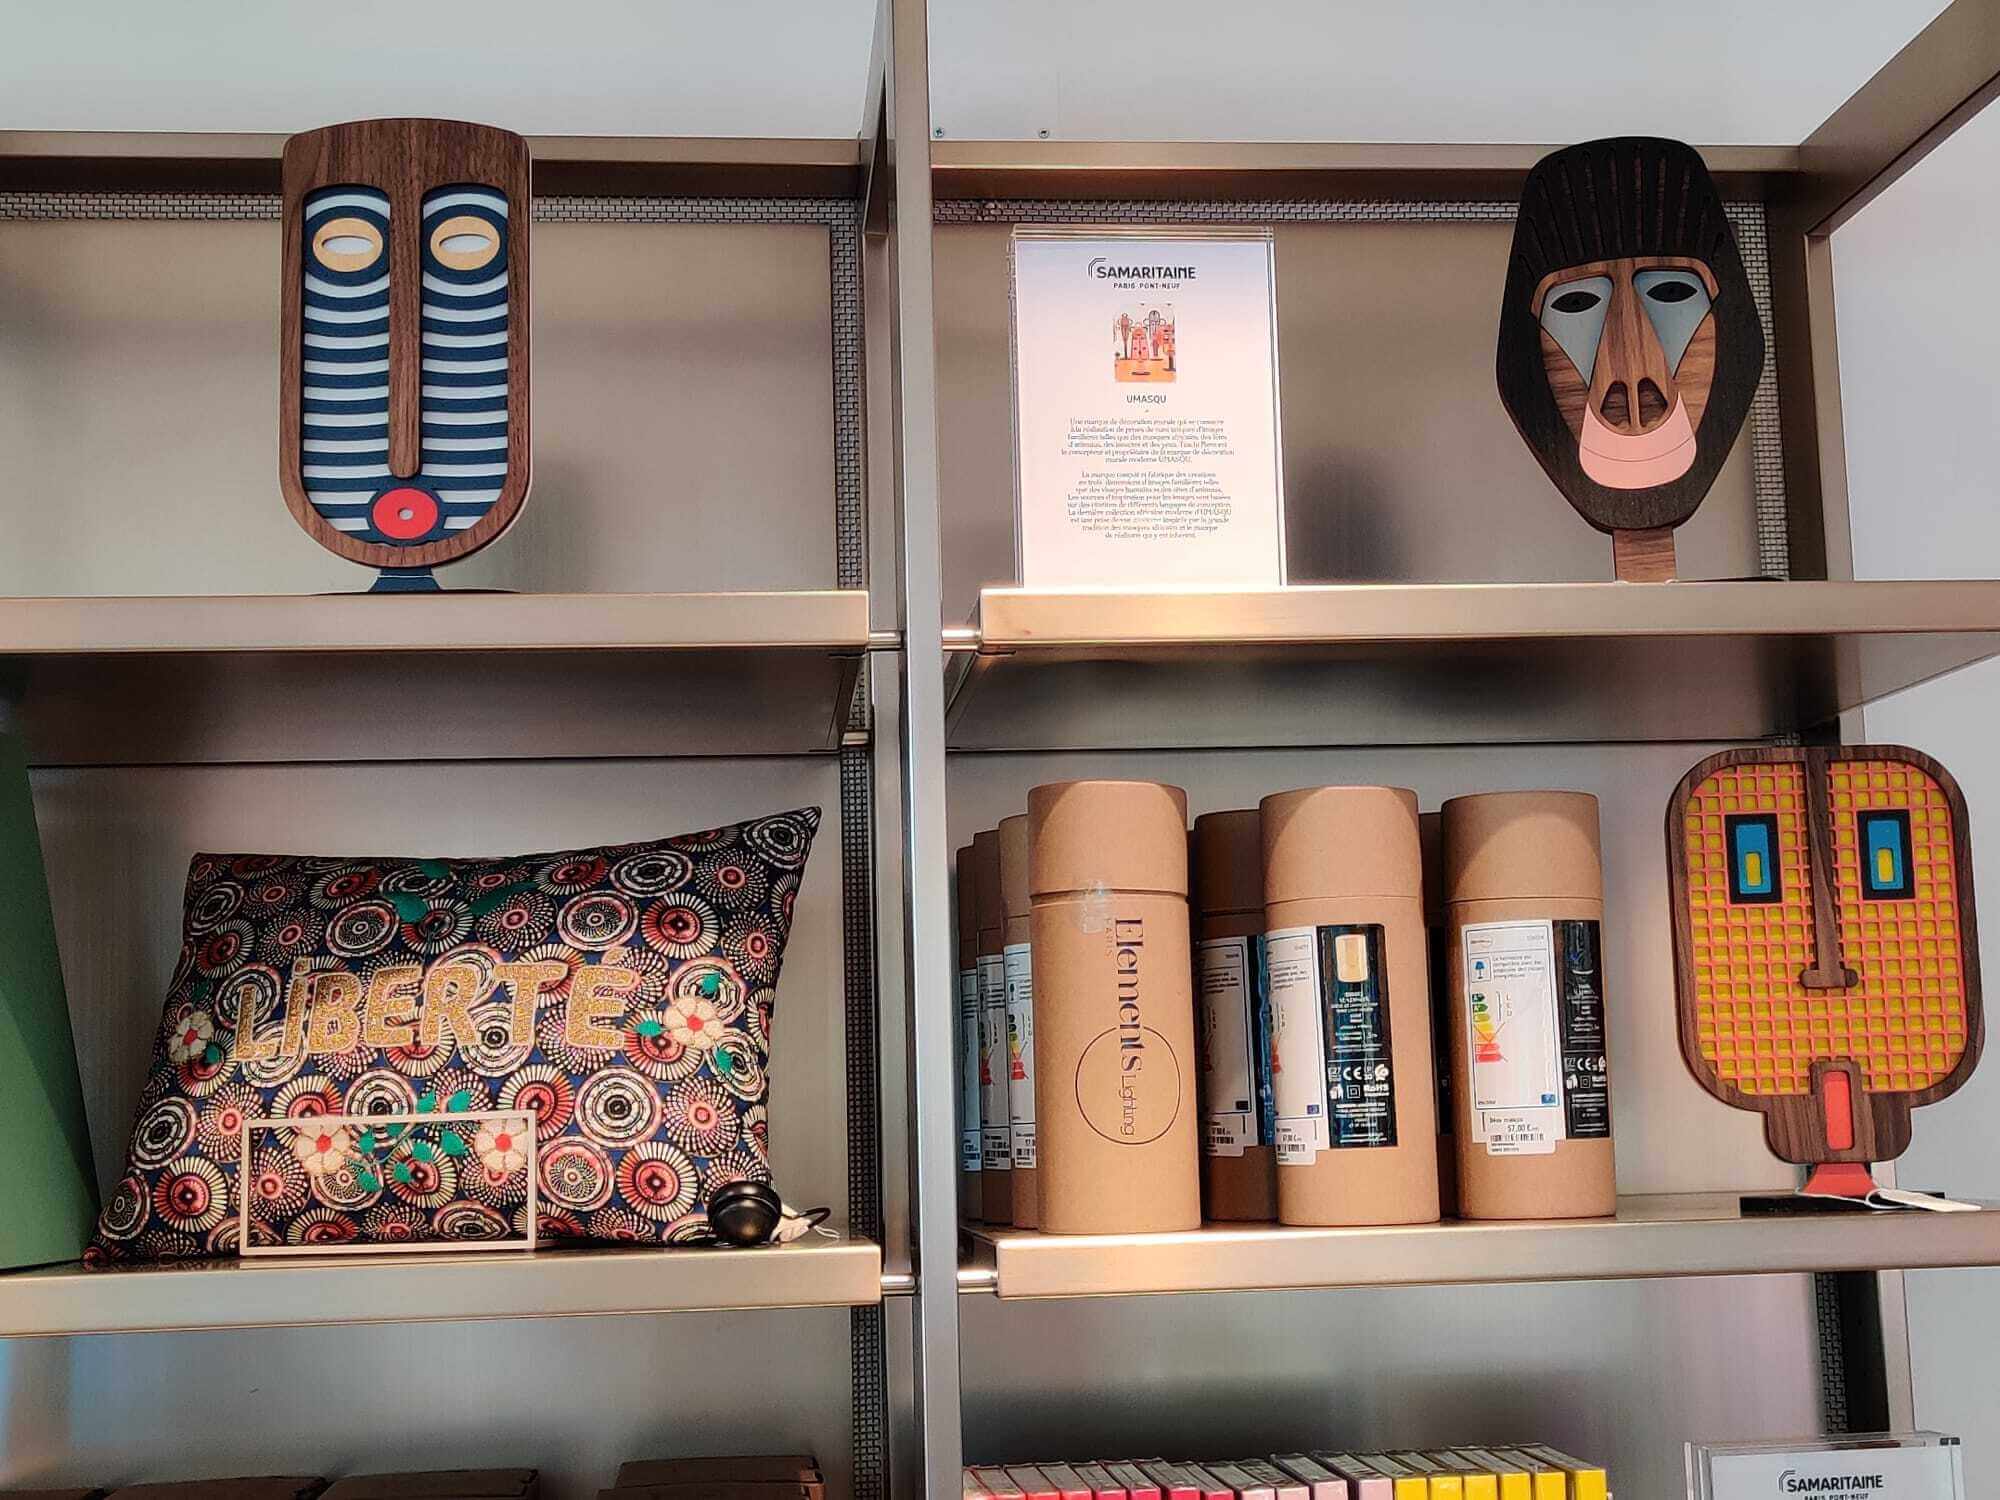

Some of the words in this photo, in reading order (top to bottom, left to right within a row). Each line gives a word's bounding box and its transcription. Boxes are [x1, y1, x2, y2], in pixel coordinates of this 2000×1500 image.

[1096, 266, 1197, 280] SAMARITAINE
[1113, 282, 1136, 290] PARIS
[1126, 394, 1167, 404] UMASQU
[233, 946, 637, 1063] LIBERTÉ
[1114, 918, 1146, 1073] Elements
[1117, 1074, 1137, 1136] Lighting
[1786, 1474, 1884, 1493] SAMARITAINE
